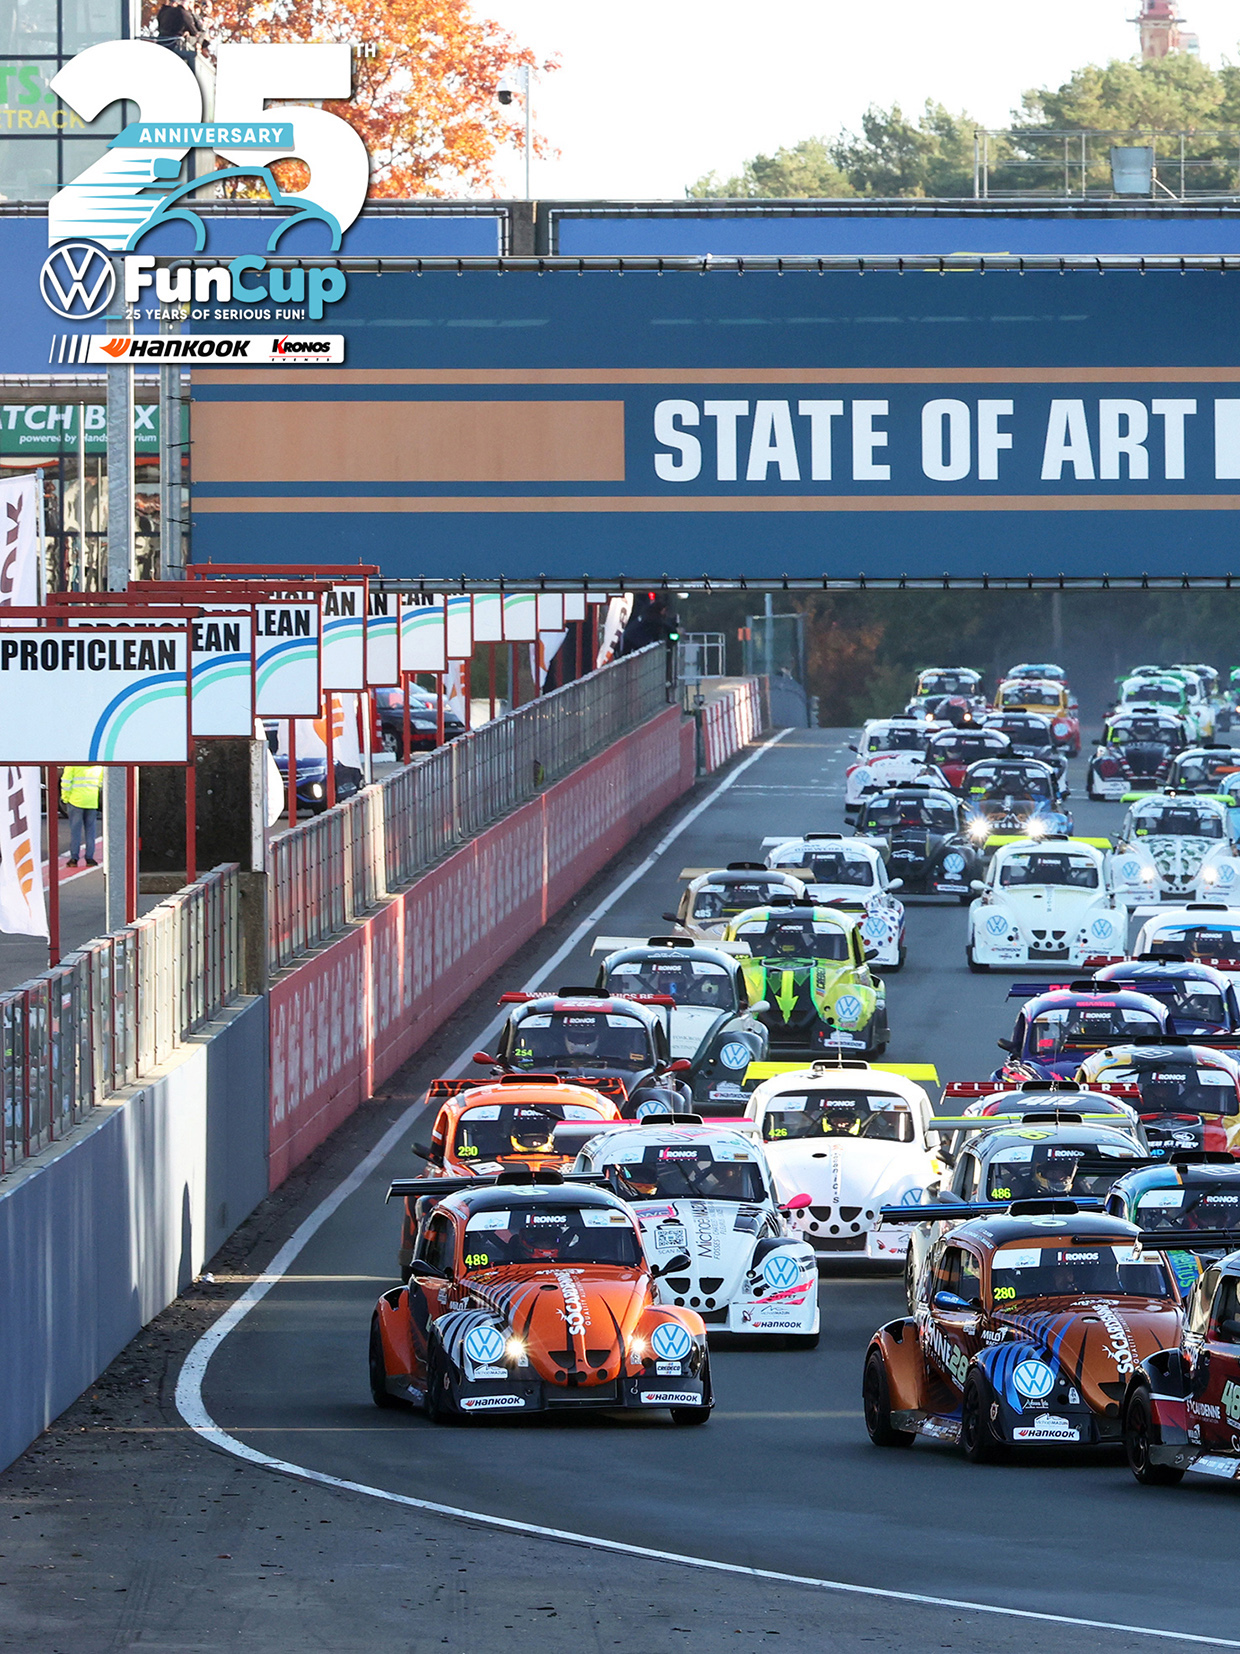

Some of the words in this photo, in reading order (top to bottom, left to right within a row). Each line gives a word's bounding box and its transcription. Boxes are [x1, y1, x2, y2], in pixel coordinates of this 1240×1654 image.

[85, 405, 159, 430] BX
[65, 433, 77, 445] by
[653, 398, 890, 482] STATE
[921, 398, 1014, 482] OF
[1040, 398, 1198, 482] ART
[1, 639, 176, 671] PROFICLEAN
[991, 1187, 1011, 1199] 486
[464, 1253, 489, 1266] 489
[994, 1287, 1016, 1300] 280
[950, 1346, 969, 1383] 28
